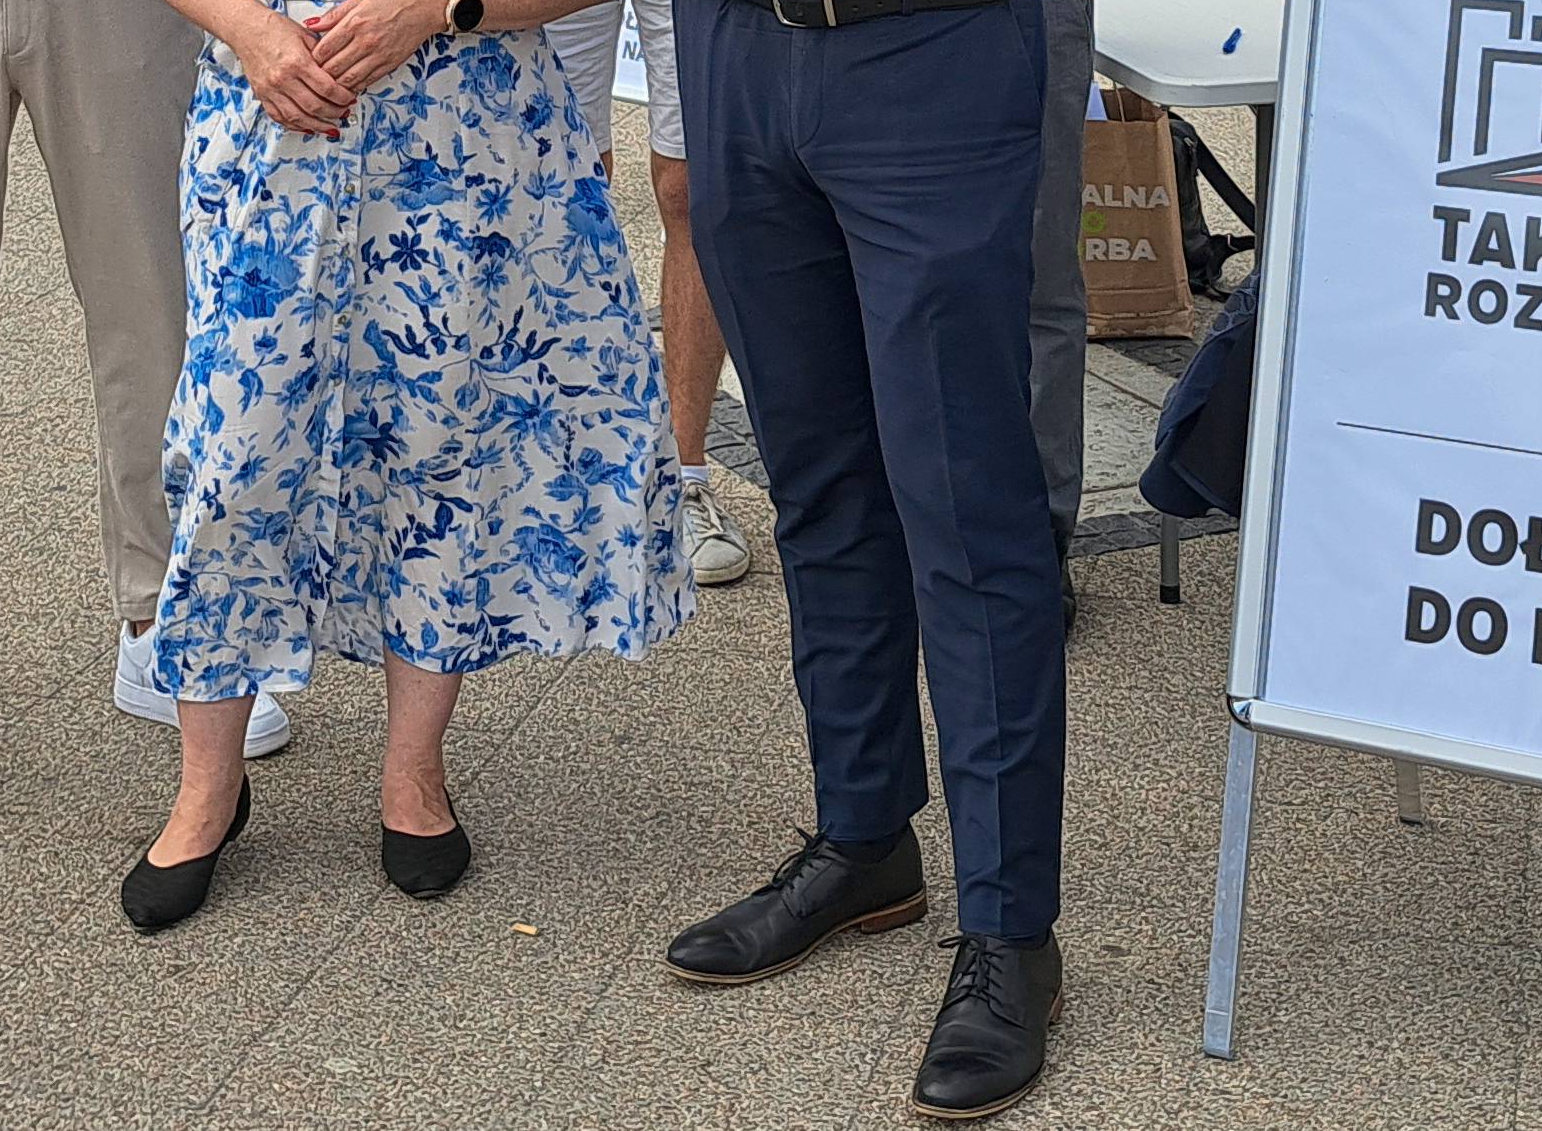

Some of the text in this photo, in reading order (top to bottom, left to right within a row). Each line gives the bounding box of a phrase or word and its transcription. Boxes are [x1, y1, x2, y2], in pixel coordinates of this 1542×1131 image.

[1082, 184, 1171, 208] ALNA
[1085, 238, 1157, 261] RBA
[1405, 586, 1508, 655] DO
